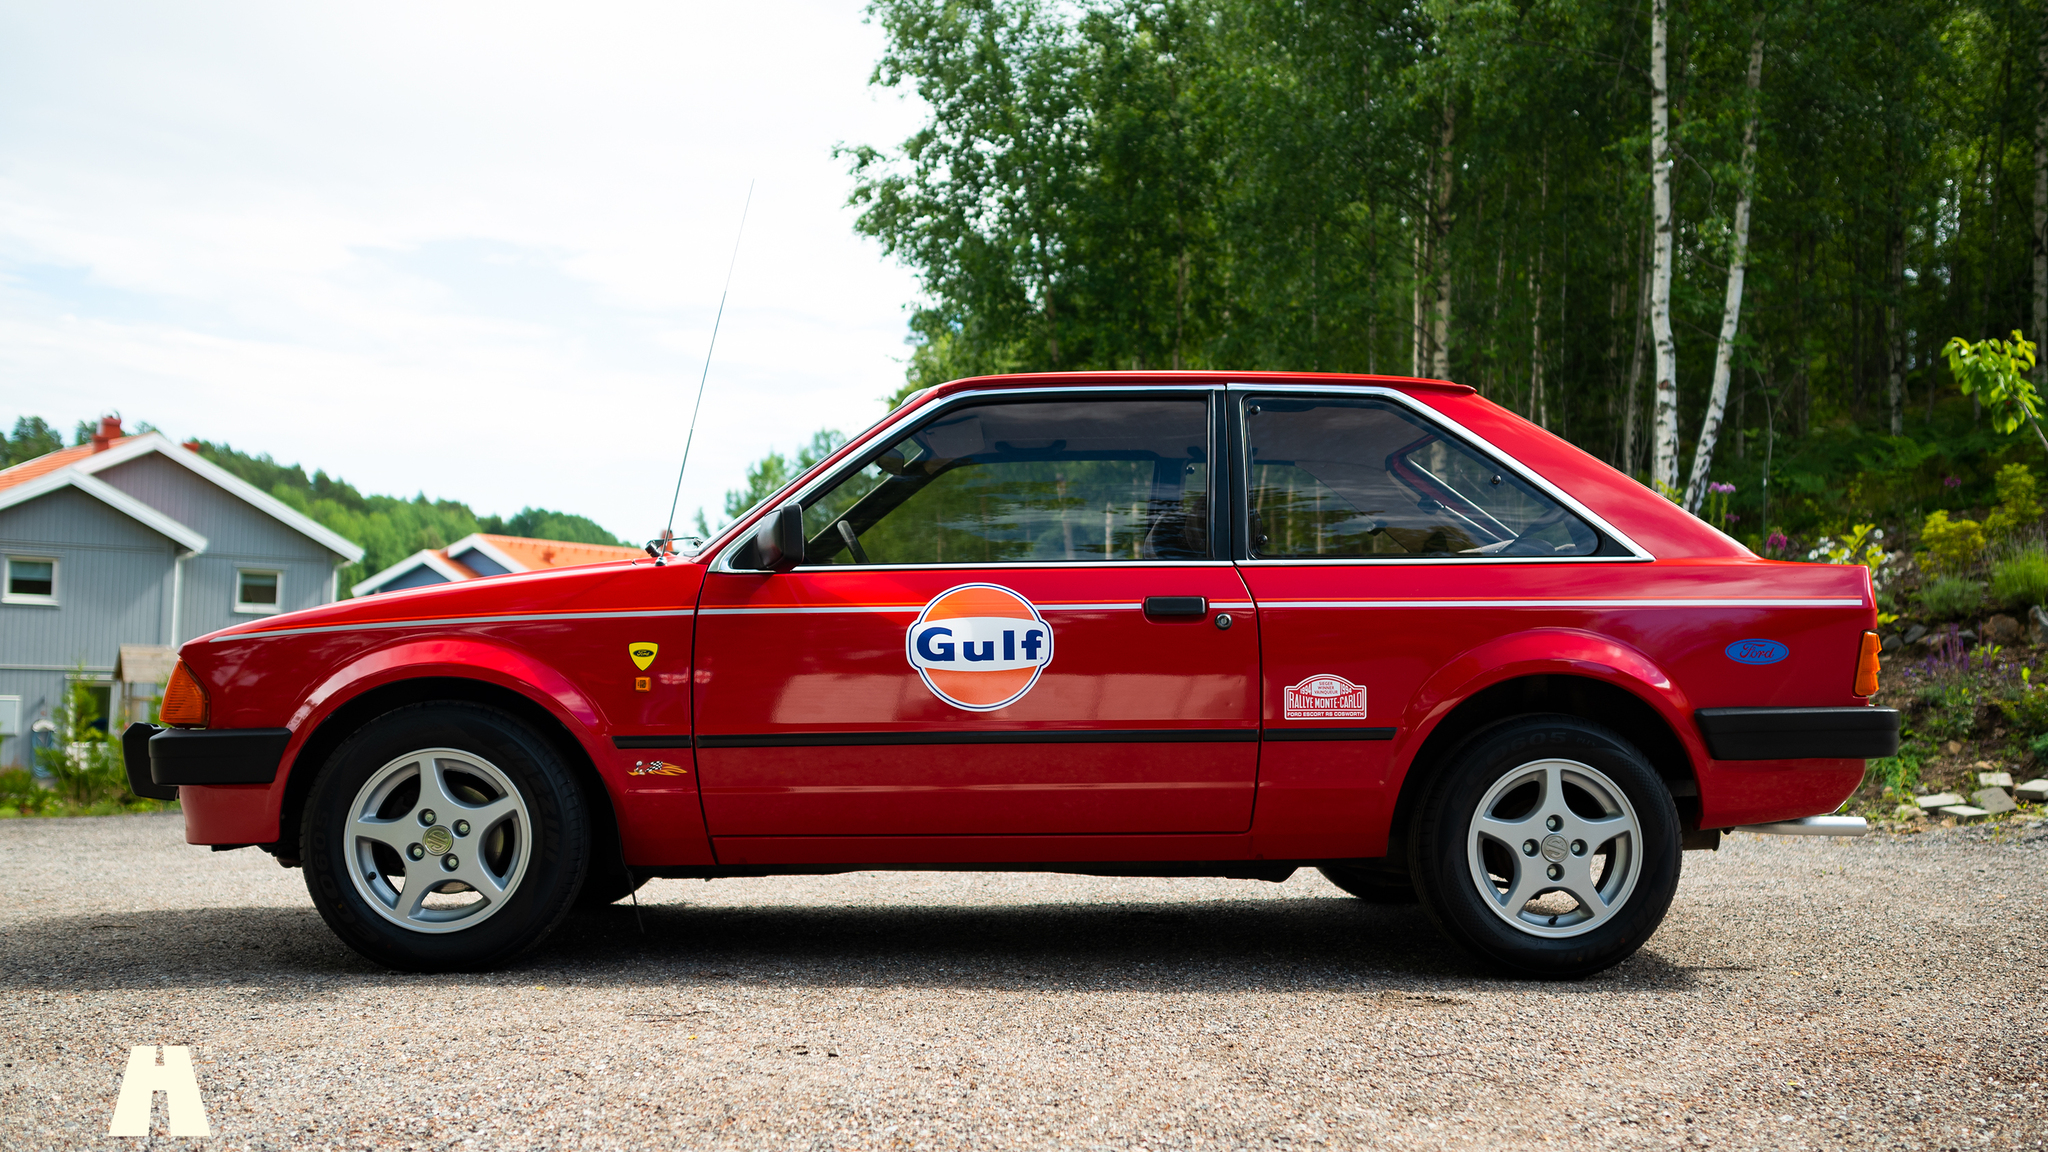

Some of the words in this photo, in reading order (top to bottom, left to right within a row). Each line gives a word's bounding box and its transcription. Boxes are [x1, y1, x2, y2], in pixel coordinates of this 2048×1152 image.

[916, 627, 1043, 662] Gulf
[1740, 643, 1775, 658] Ford
[1289, 692, 1313, 709] RALLYE
[1315, 692, 1362, 709] MONTE-CARLO
